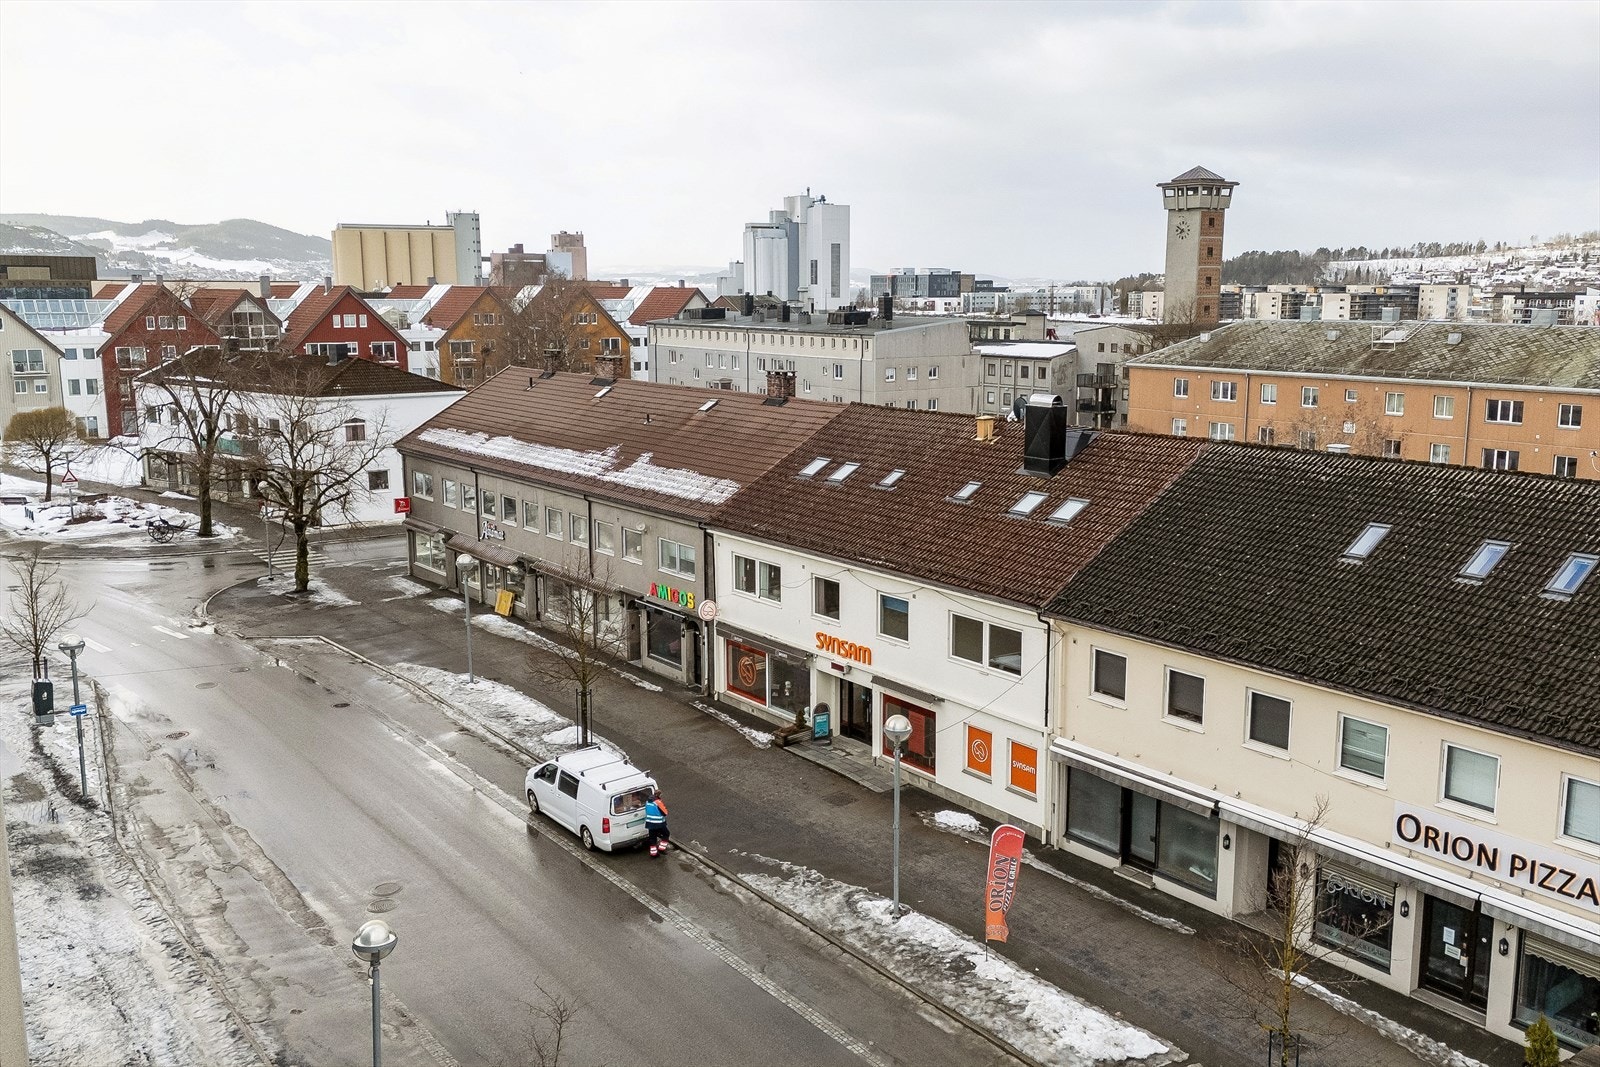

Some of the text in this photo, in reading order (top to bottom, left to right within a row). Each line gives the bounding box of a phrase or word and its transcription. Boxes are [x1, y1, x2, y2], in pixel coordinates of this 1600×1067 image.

[649, 581, 695, 609] AMIGOS
[816, 632, 872, 665] SYNSAM
[1396, 813, 1600, 906] ORION PIZZA
[1003, 889, 1013, 912] PIZZA
